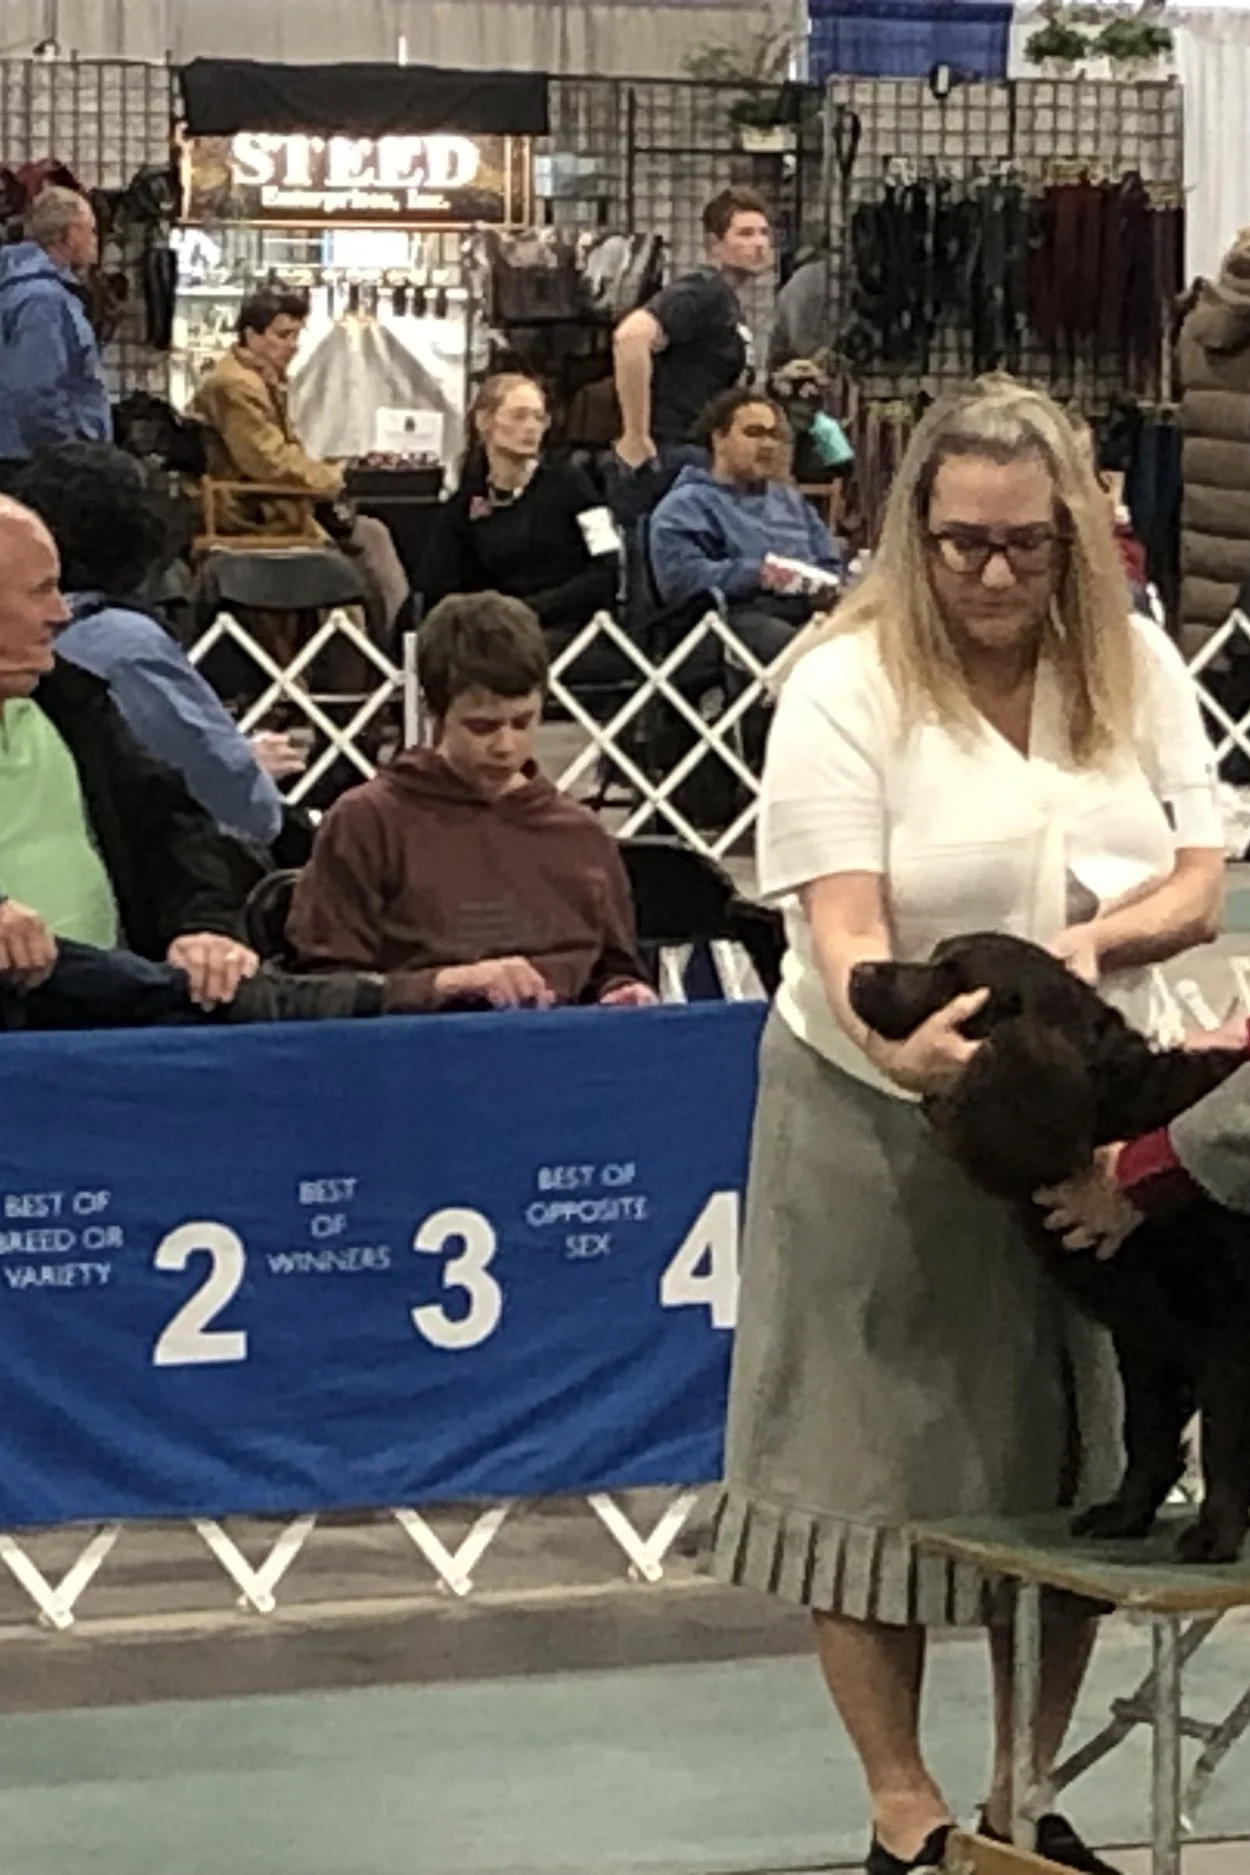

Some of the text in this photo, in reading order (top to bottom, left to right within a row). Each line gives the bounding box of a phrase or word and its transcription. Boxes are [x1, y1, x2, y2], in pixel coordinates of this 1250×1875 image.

[231, 132, 480, 188] STEED
[299, 1178, 357, 1204] BEST
[537, 1162, 637, 1191] BEST OF
[4, 1189, 111, 1218] BEST OF
[525, 1196, 649, 1228] OPPOSITE
[82, 1225, 124, 1250] OR
[311, 1213, 348, 1239] OF
[266, 1246, 392, 1274] WINNERS
[565, 1234, 614, 1260] SEX
[661, 1190, 741, 1329] 4
[3, 1261, 111, 1289] VARIETY
[411, 1207, 502, 1349] 3
[153, 1221, 247, 1366] 2
